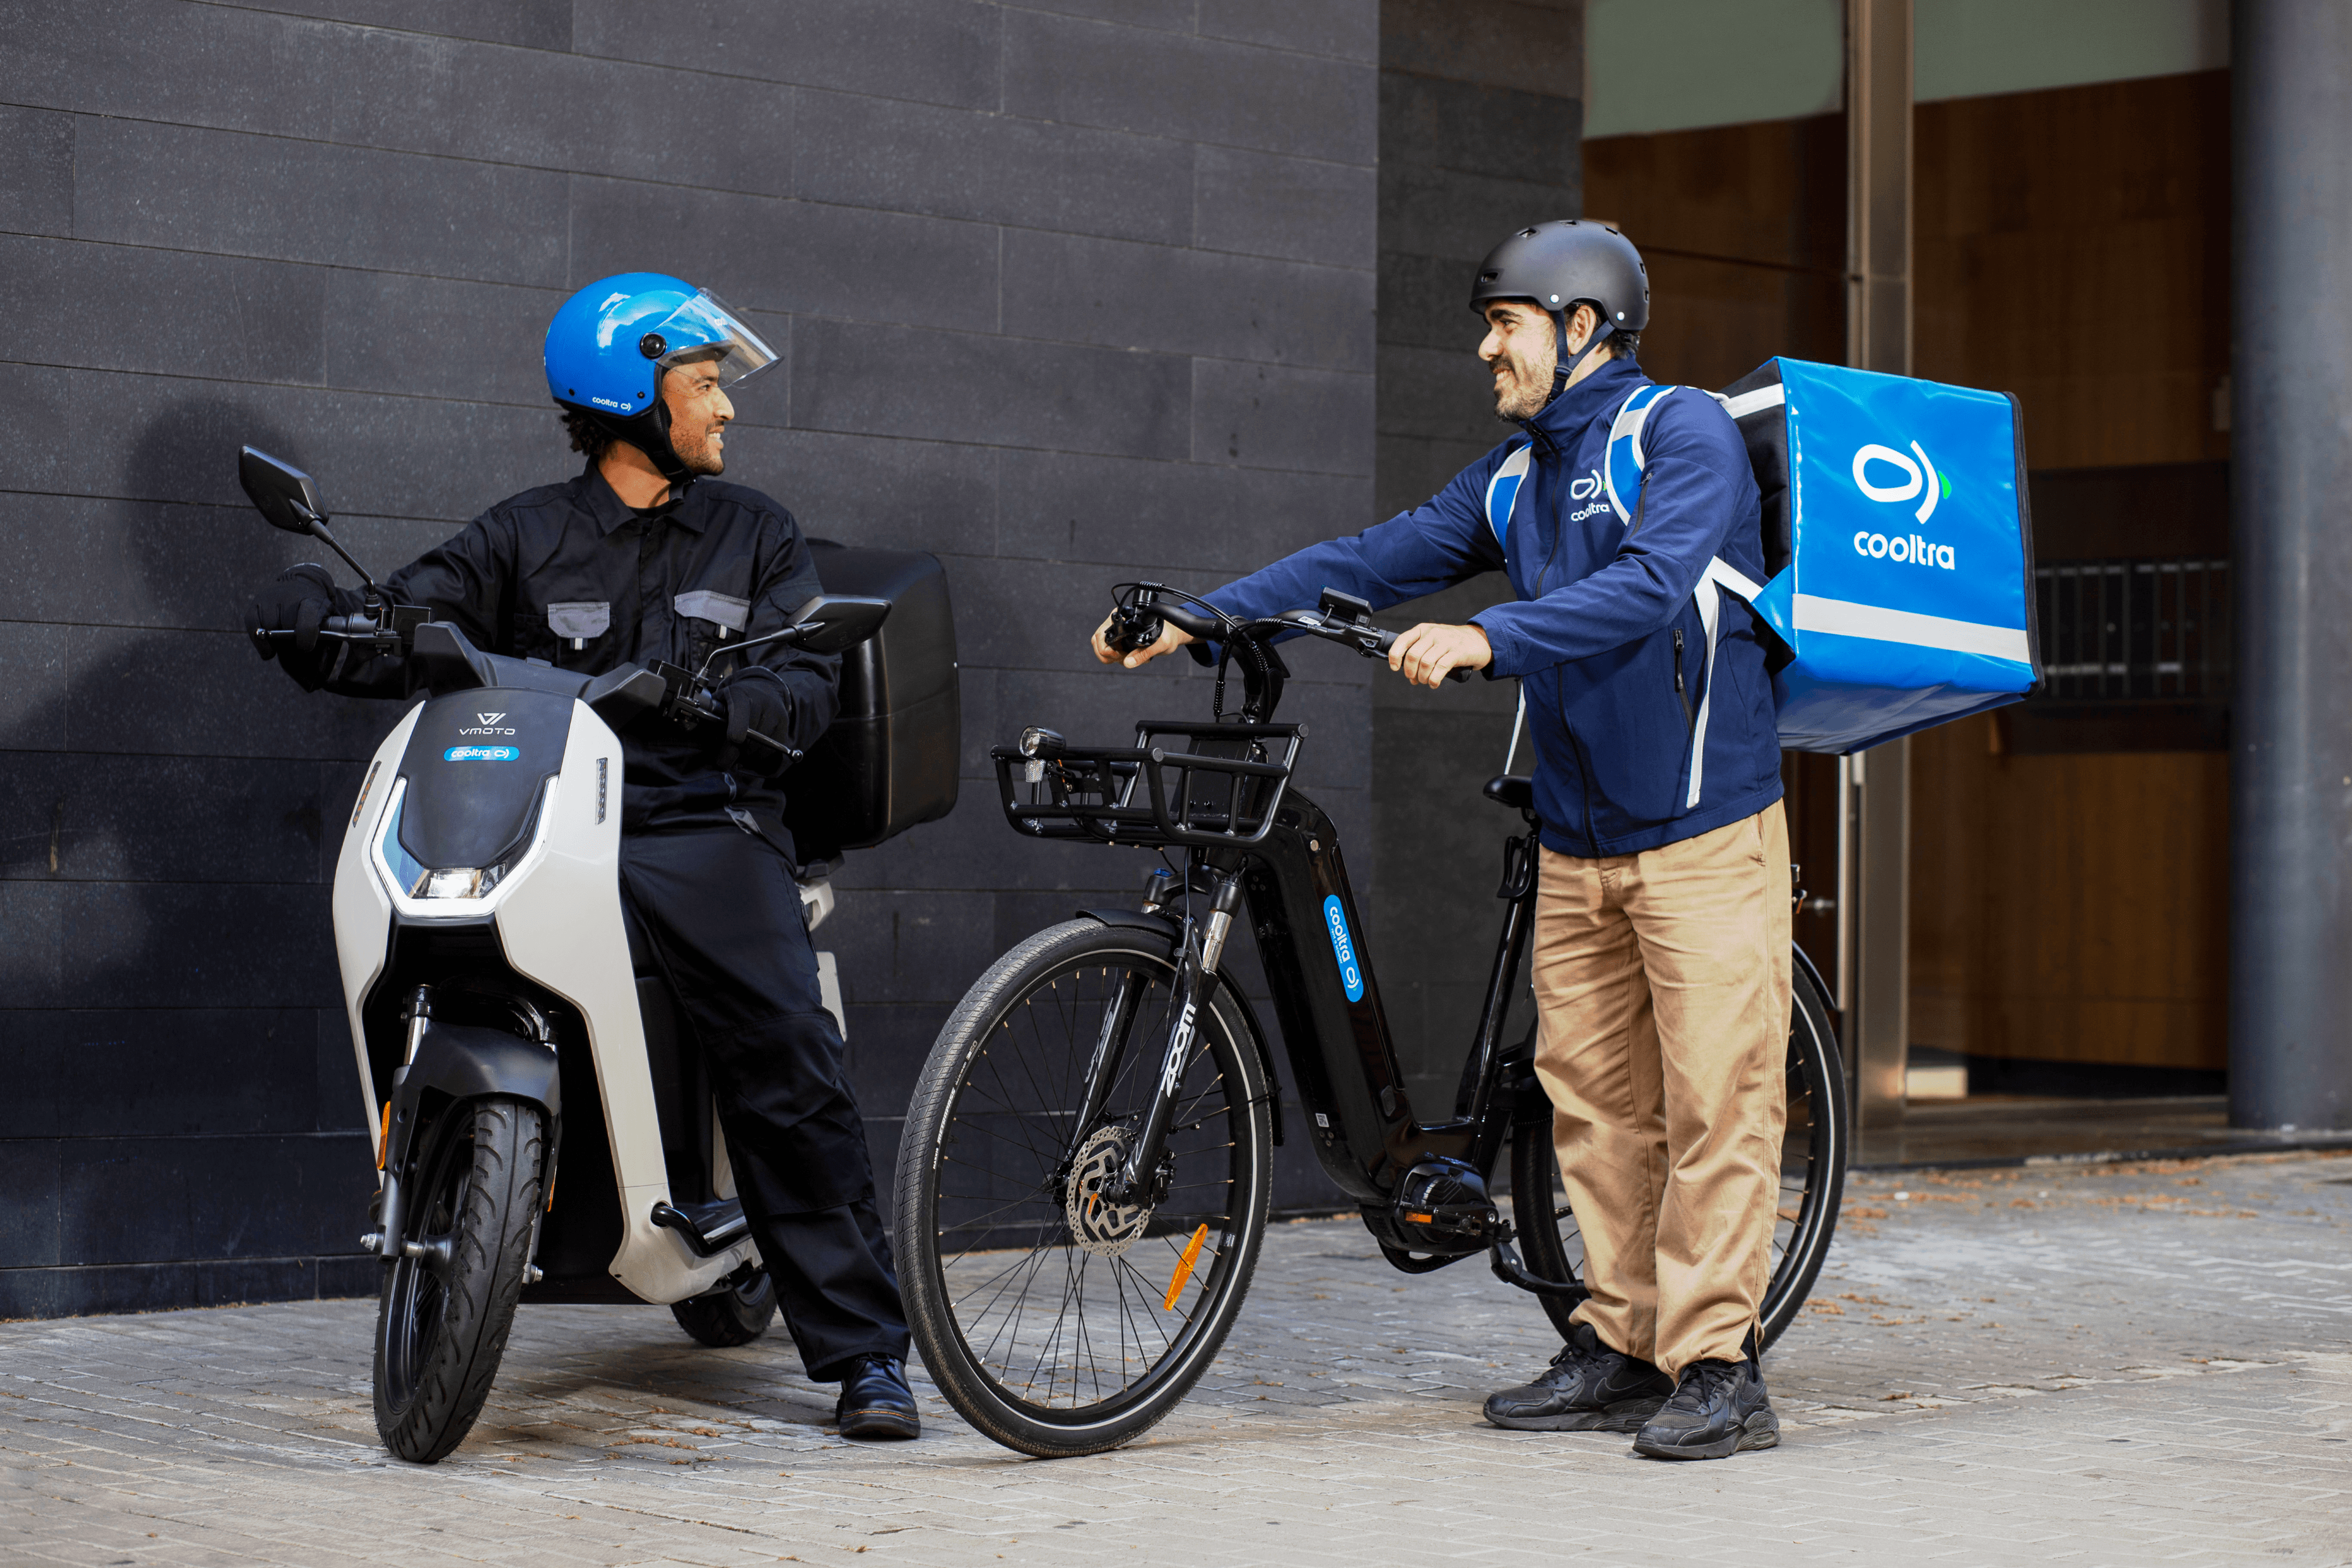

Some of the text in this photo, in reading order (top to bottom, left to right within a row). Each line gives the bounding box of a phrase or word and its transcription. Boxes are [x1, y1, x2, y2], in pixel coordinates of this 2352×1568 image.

[592, 396, 618, 408] cooltra
[1570, 502, 1610, 521] cooltra
[1854, 531, 1955, 570] cooltra
[451, 748, 491, 758] cooltra
[1330, 906, 1351, 963] cooltra
